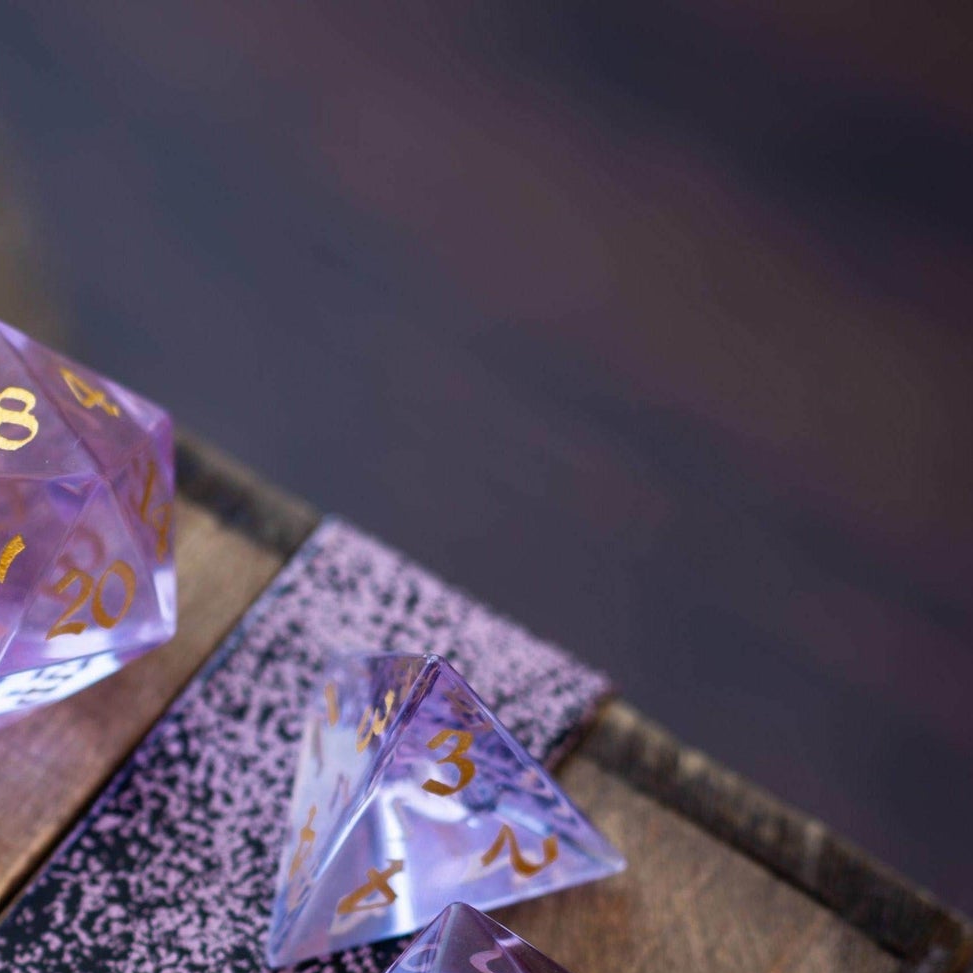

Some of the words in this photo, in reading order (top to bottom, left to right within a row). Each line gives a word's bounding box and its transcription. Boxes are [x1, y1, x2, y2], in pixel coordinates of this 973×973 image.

[59, 368, 121, 418] 4
[45, 560, 137, 641] 20
[421, 728, 476, 796] 3
[481, 823, 560, 879] 2
[336, 859, 404, 916] 4
